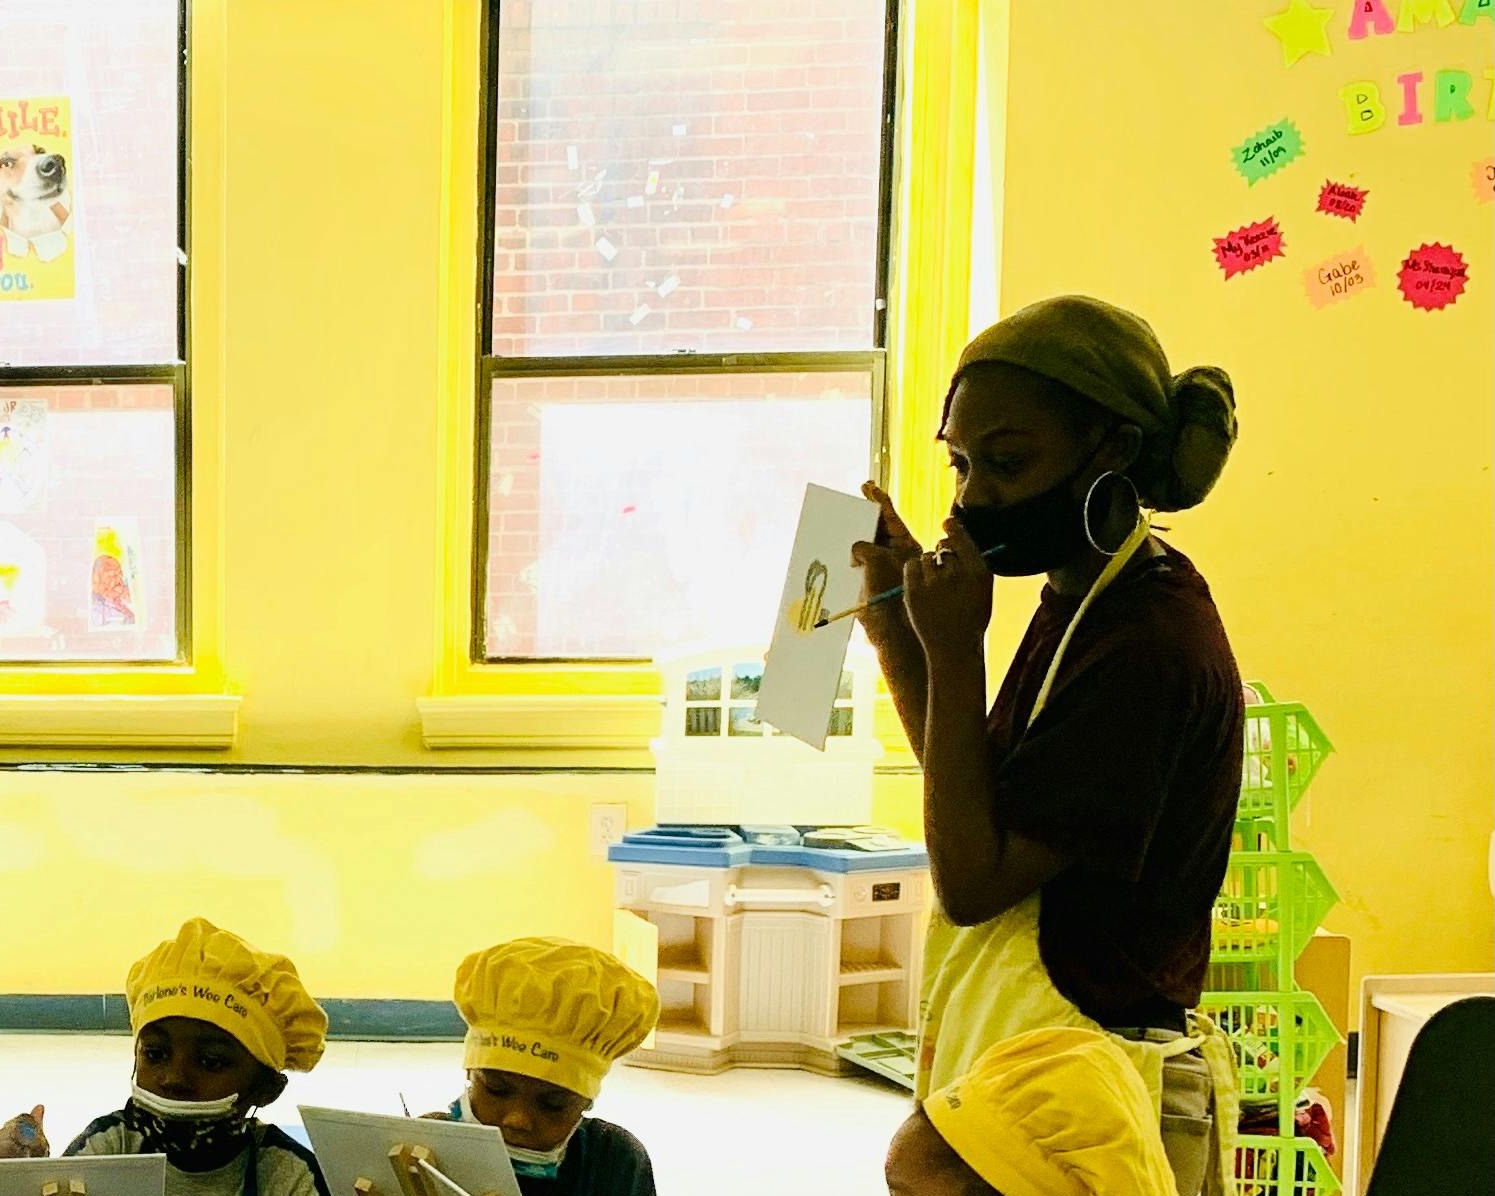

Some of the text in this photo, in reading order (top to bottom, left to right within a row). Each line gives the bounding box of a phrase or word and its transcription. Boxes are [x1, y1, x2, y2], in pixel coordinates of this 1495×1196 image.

[1318, 259, 1360, 285] Gabe
[1330, 273, 1364, 297] 10/03
[194, 985, 221, 1002] Wee
[224, 994, 248, 1018] Care
[531, 1042, 560, 1062] Care
